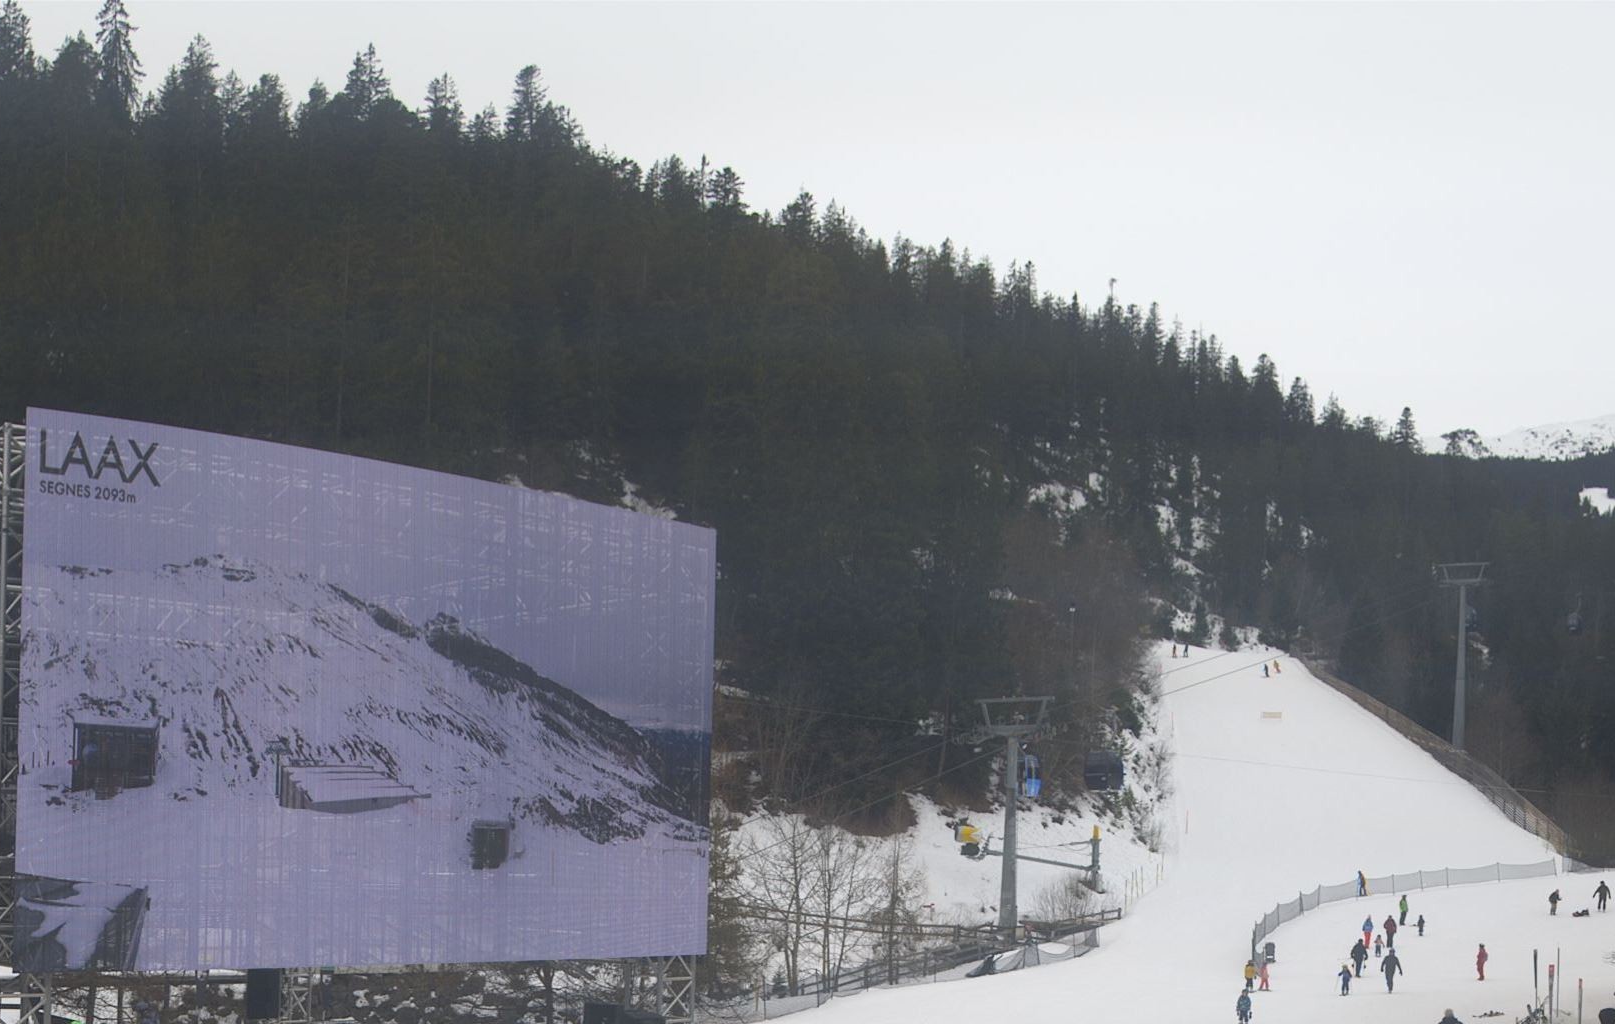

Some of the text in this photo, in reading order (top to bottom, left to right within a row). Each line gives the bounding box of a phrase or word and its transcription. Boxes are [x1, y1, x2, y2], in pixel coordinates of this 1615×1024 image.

[40, 428, 160, 487] LAAX
[39, 480, 136, 503] SEGNES 2093m
